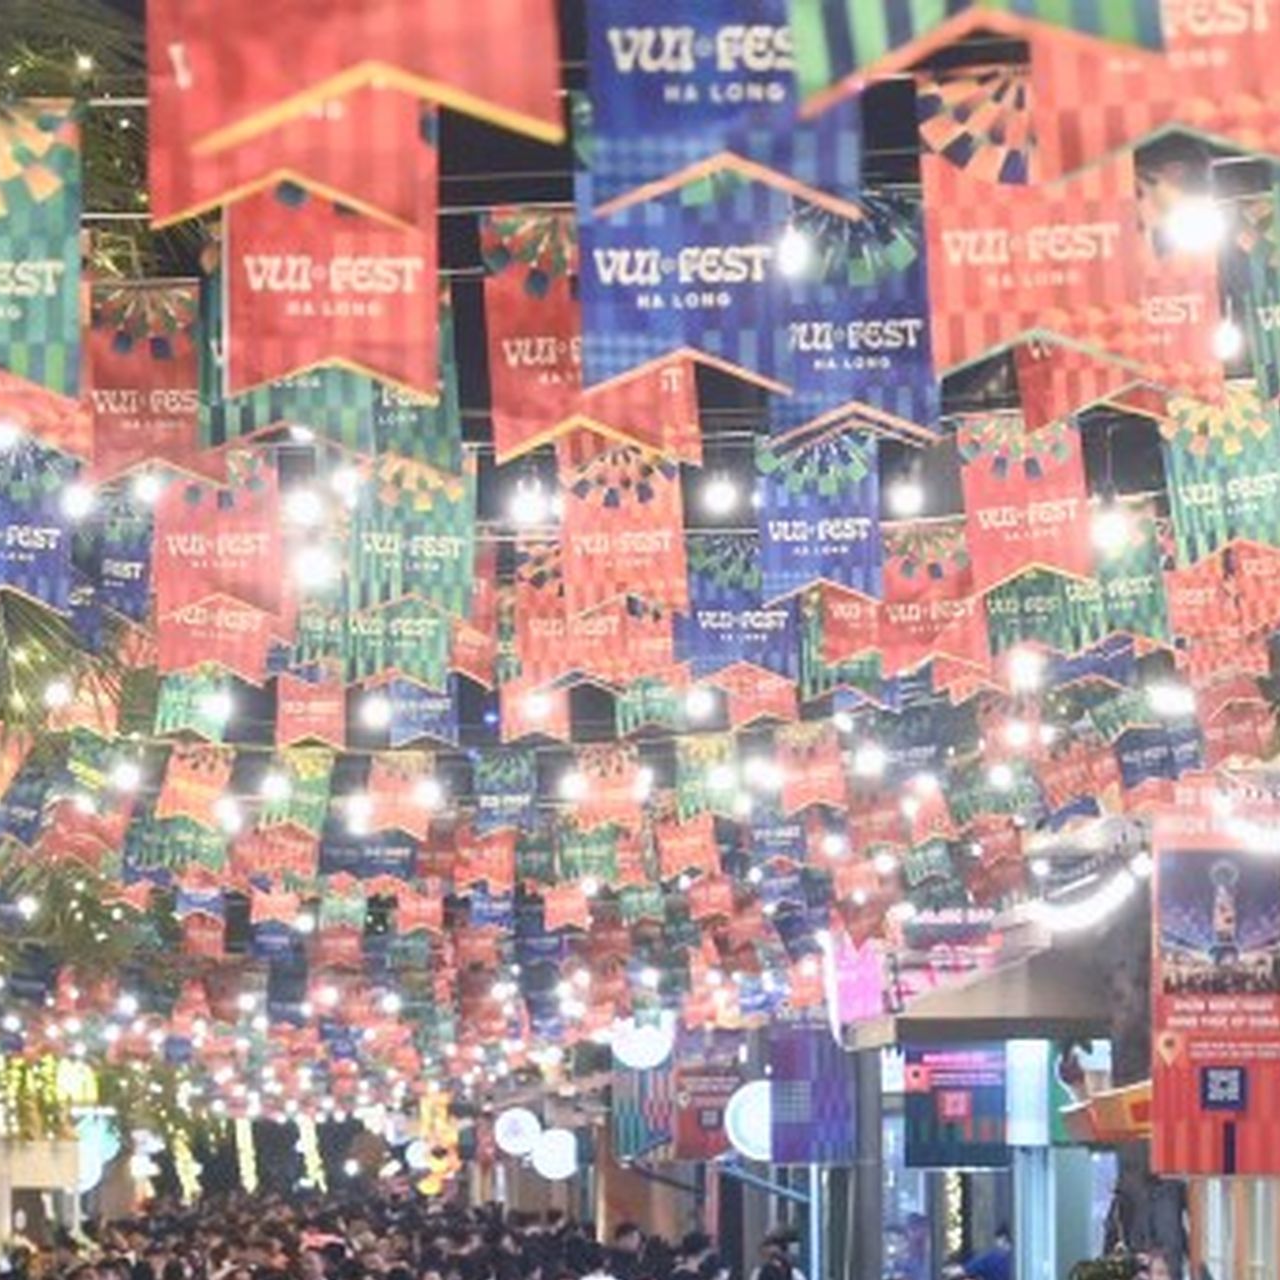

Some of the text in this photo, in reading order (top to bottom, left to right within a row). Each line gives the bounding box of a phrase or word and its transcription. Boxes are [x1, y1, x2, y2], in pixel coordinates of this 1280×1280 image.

[608, 26, 795, 73] VUI FES
[665, 85, 785, 103] HA LONG
[941, 223, 1120, 265] VUI FEST
[244, 255, 425, 293] VUI FEST
[594, 246, 773, 284] VUI FEST
[323, 304, 382, 317] LONG
[637, 293, 731, 309] HA LONG
[1145, 295, 1203, 324] EST
[848, 318, 923, 349] FEST
[502, 339, 558, 367] VUI
[814, 356, 891, 369] HA LONG
[148, 390, 198, 412] FES
[1228, 476, 1280, 502] FEST
[1028, 502, 1077, 526] FEST
[5, 521, 62, 549] FEST
[768, 518, 871, 541] VUI FEST
[218, 534, 270, 557] FEST
[411, 535, 463, 560] FEST
[620, 531, 671, 553] FEST
[742, 609, 789, 631] FEST
